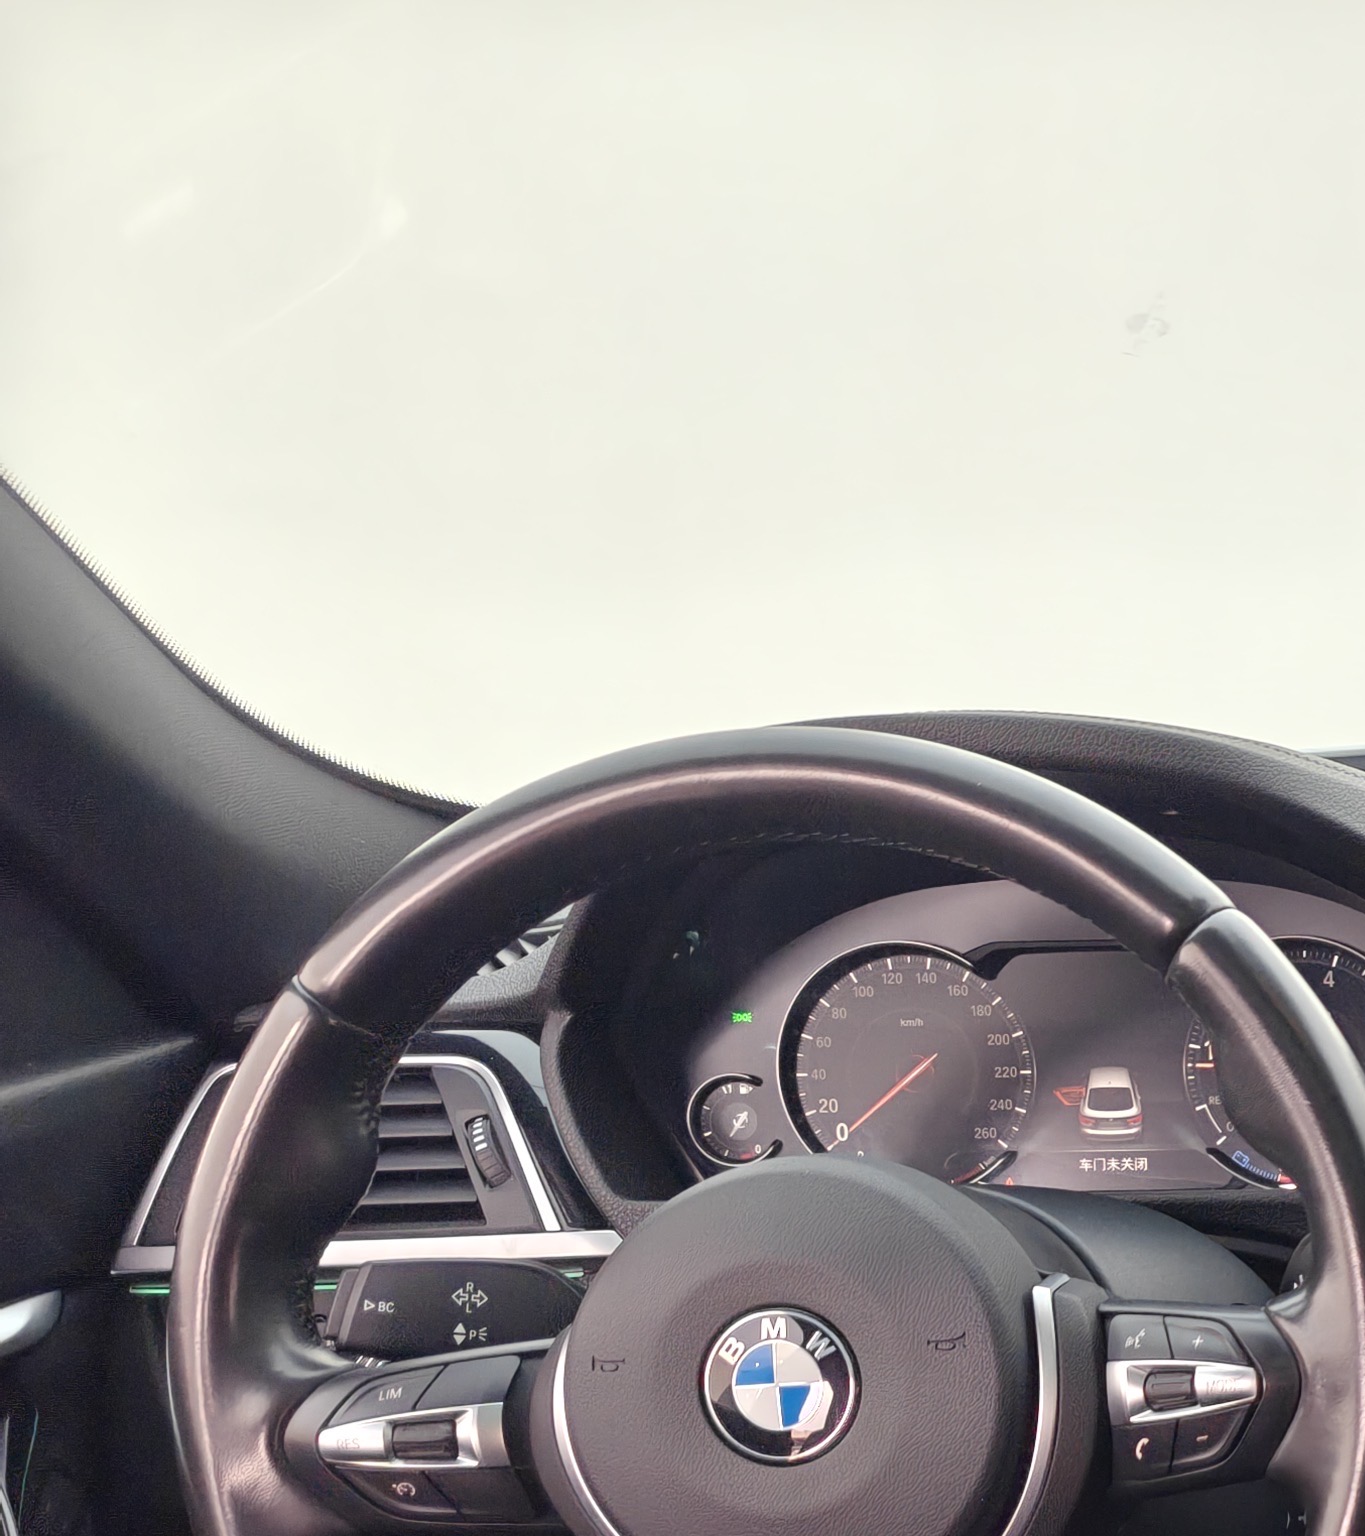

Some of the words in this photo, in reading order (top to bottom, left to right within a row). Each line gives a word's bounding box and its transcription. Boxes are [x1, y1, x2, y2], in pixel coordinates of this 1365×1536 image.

[882, 973, 903, 984] 120
[916, 973, 937, 984] 140
[1323, 970, 1335, 988] 4
[853, 986, 874, 997] 100
[948, 984, 969, 996] 160
[832, 1007, 847, 1019] 80
[971, 1004, 992, 1017] 180
[900, 1018, 924, 1027] km/h
[816, 1036, 832, 1048] 60
[987, 1033, 1010, 1045] 200
[811, 1069, 827, 1080] 40
[994, 1066, 1018, 1078] 220
[818, 1098, 839, 1113] 20
[990, 1099, 1012, 1111] 240
[836, 1122, 849, 1142] 0
[974, 1128, 997, 1140] 260
[1079, 1157, 1148, 1172] 车门未关闭
[466, 1281, 474, 1293] R
[377, 1301, 395, 1313] BC
[718, 1317, 837, 1361] BMW
[379, 1387, 403, 1401] LIM
[336, 1437, 360, 1450] RES
